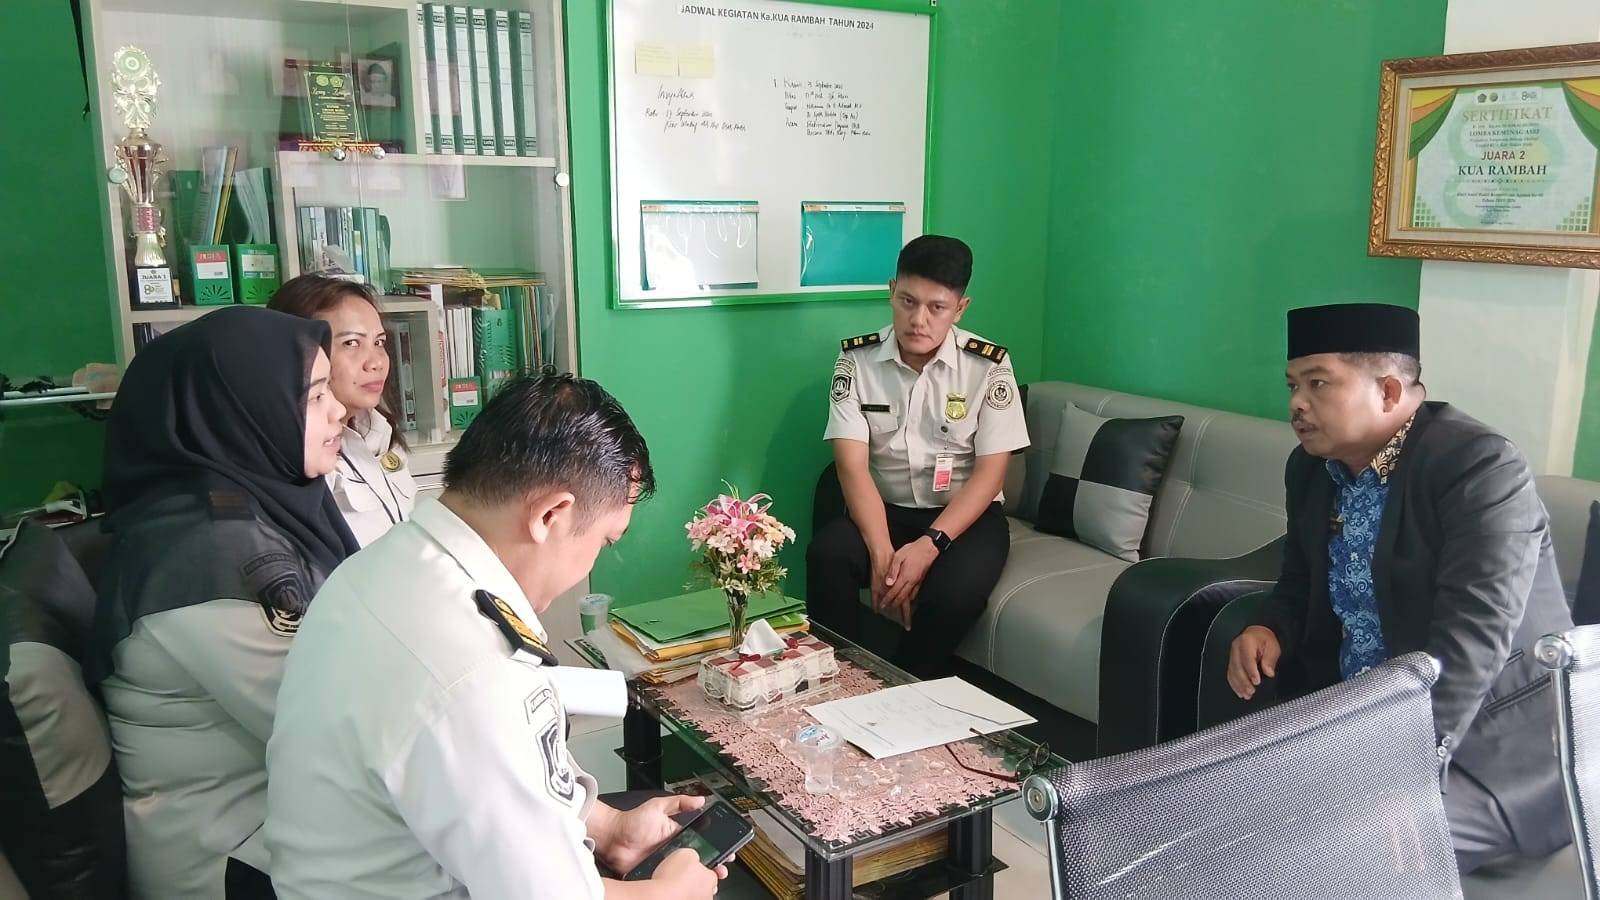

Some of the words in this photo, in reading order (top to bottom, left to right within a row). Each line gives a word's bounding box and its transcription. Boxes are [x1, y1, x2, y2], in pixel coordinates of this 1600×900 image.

[681, 5, 716, 17] JADWAL
[717, 8, 759, 20] KEGIATAN
[791, 15, 826, 25] RAMBAH
[828, 17, 855, 28] TAHUN
[856, 20, 874, 30] 2024
[1462, 106, 1553, 121] SERTIFIKAT
[1481, 150, 1516, 161] JUARA
[1519, 150, 1526, 160] 2
[1458, 165, 1484, 176] KUA
[1488, 164, 1547, 176] RAMBAH
